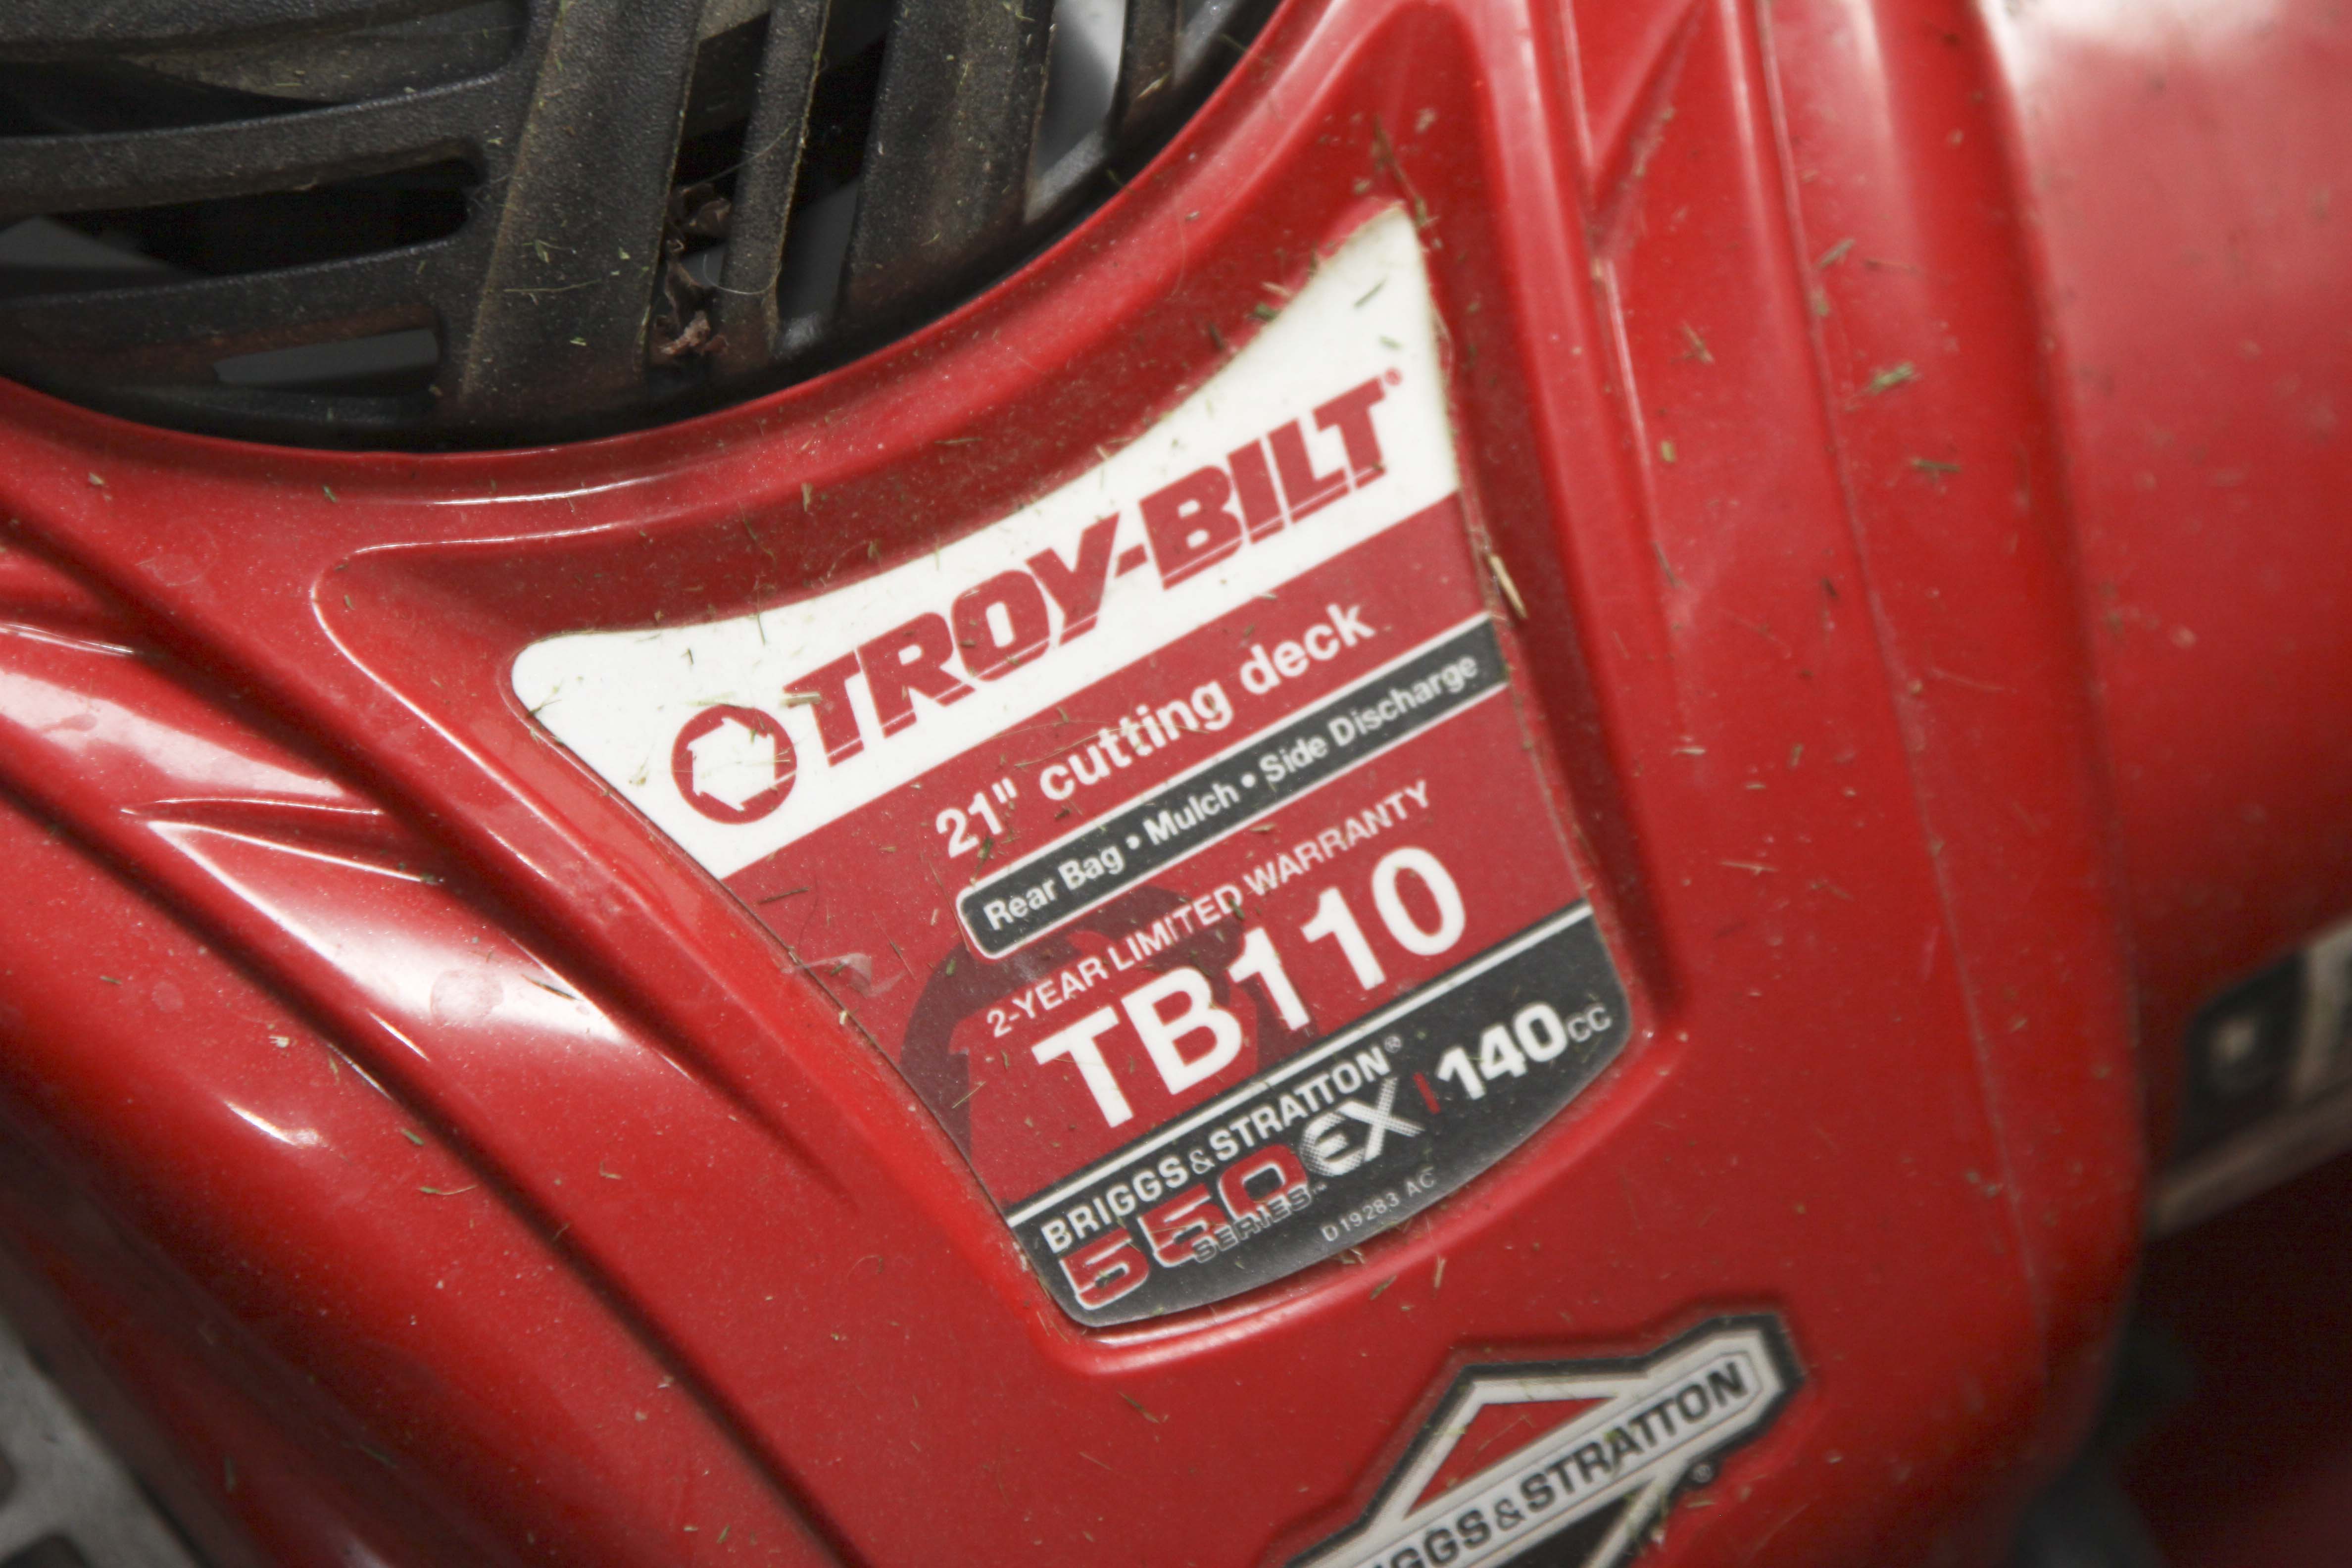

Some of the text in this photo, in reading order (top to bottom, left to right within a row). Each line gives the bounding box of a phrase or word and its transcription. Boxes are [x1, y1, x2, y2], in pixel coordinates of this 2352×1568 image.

[783, 376, 1386, 767] TROY-BILT
[936, 604, 1375, 858] 21" cutting deck
[982, 655, 1478, 931] Rear Bag Mulch Side Discharge
[987, 780, 1429, 1038] 2-YEAR LIMITED WARRANTY
[1031, 846, 1466, 1128] TB110
[1192, 1183, 1311, 1263] SERIES
